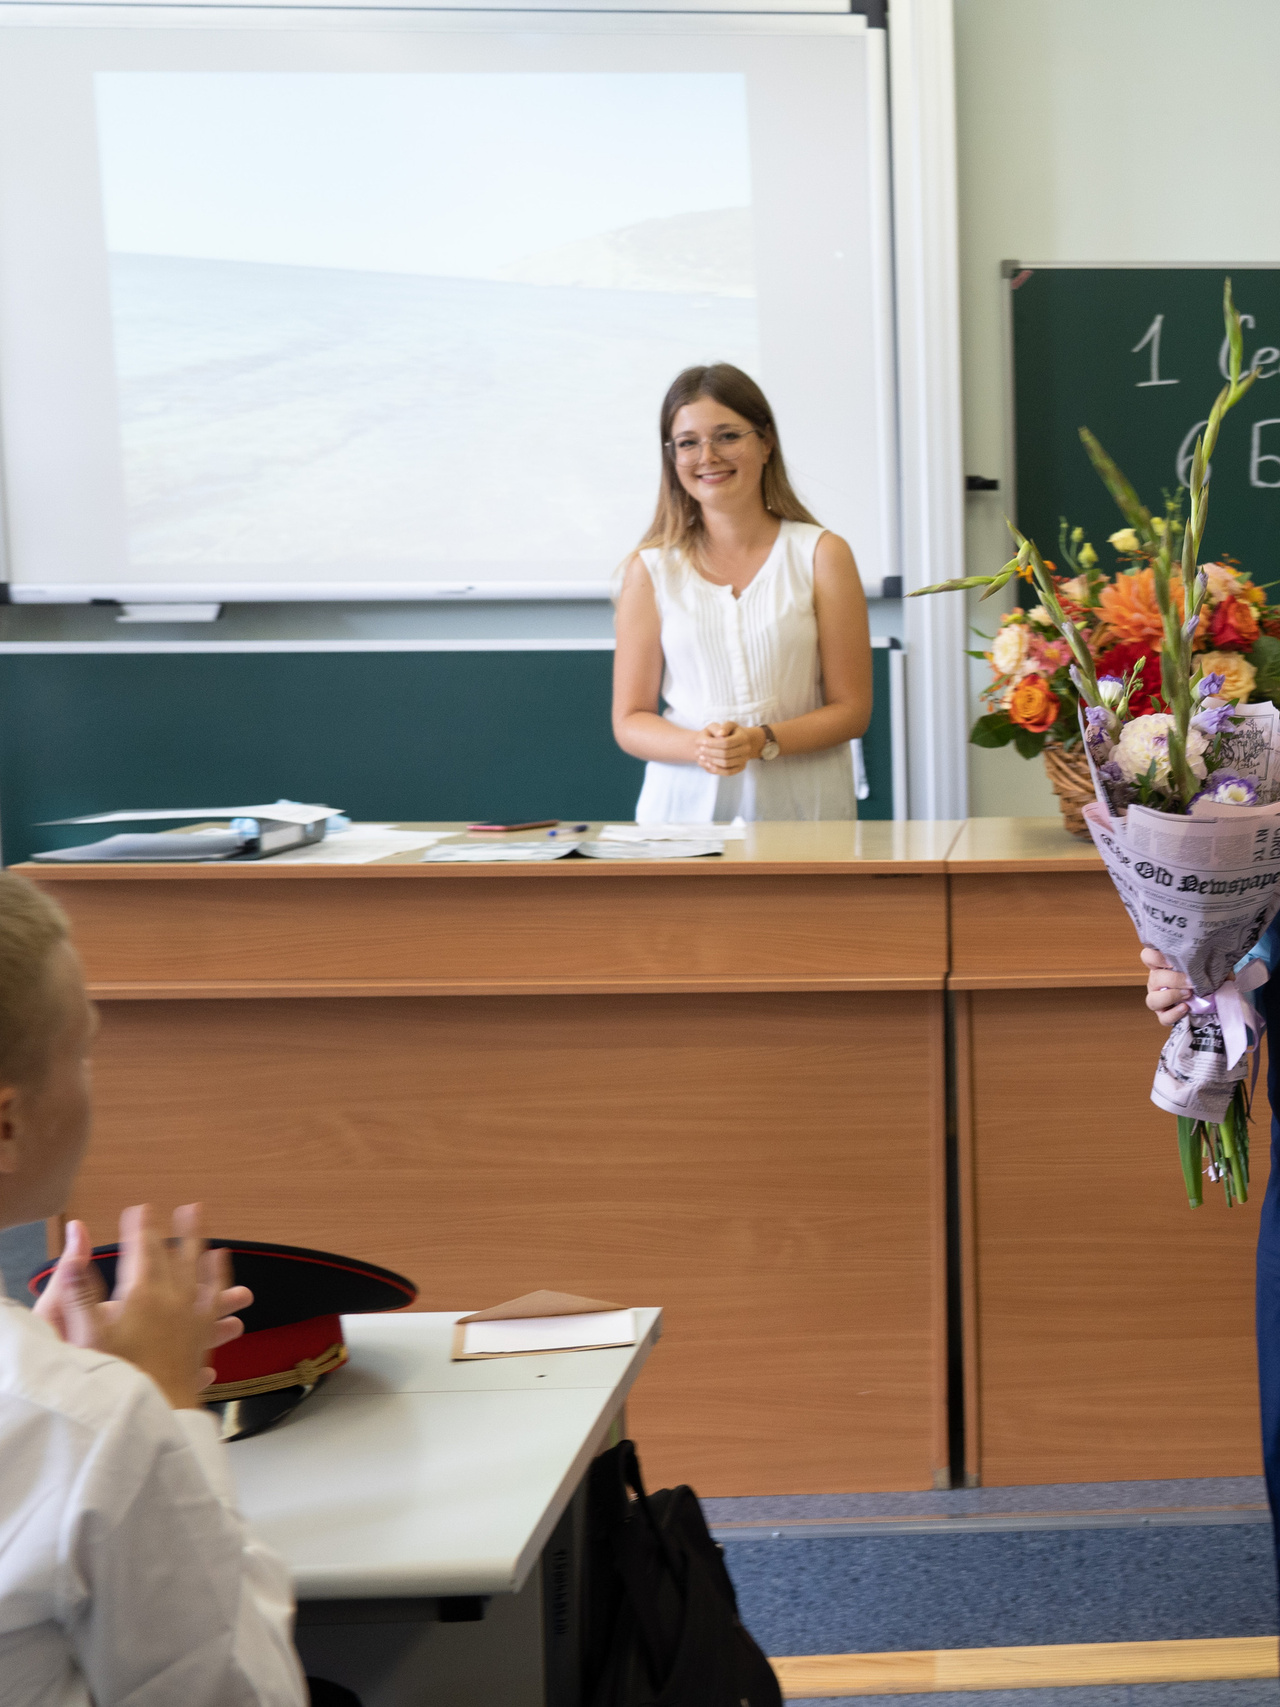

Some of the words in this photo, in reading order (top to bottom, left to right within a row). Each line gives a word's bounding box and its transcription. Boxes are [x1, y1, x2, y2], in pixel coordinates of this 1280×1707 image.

[1131, 314, 1180, 388] 1
[1176, 418, 1212, 490] 6
[1134, 861, 1174, 887] Old
